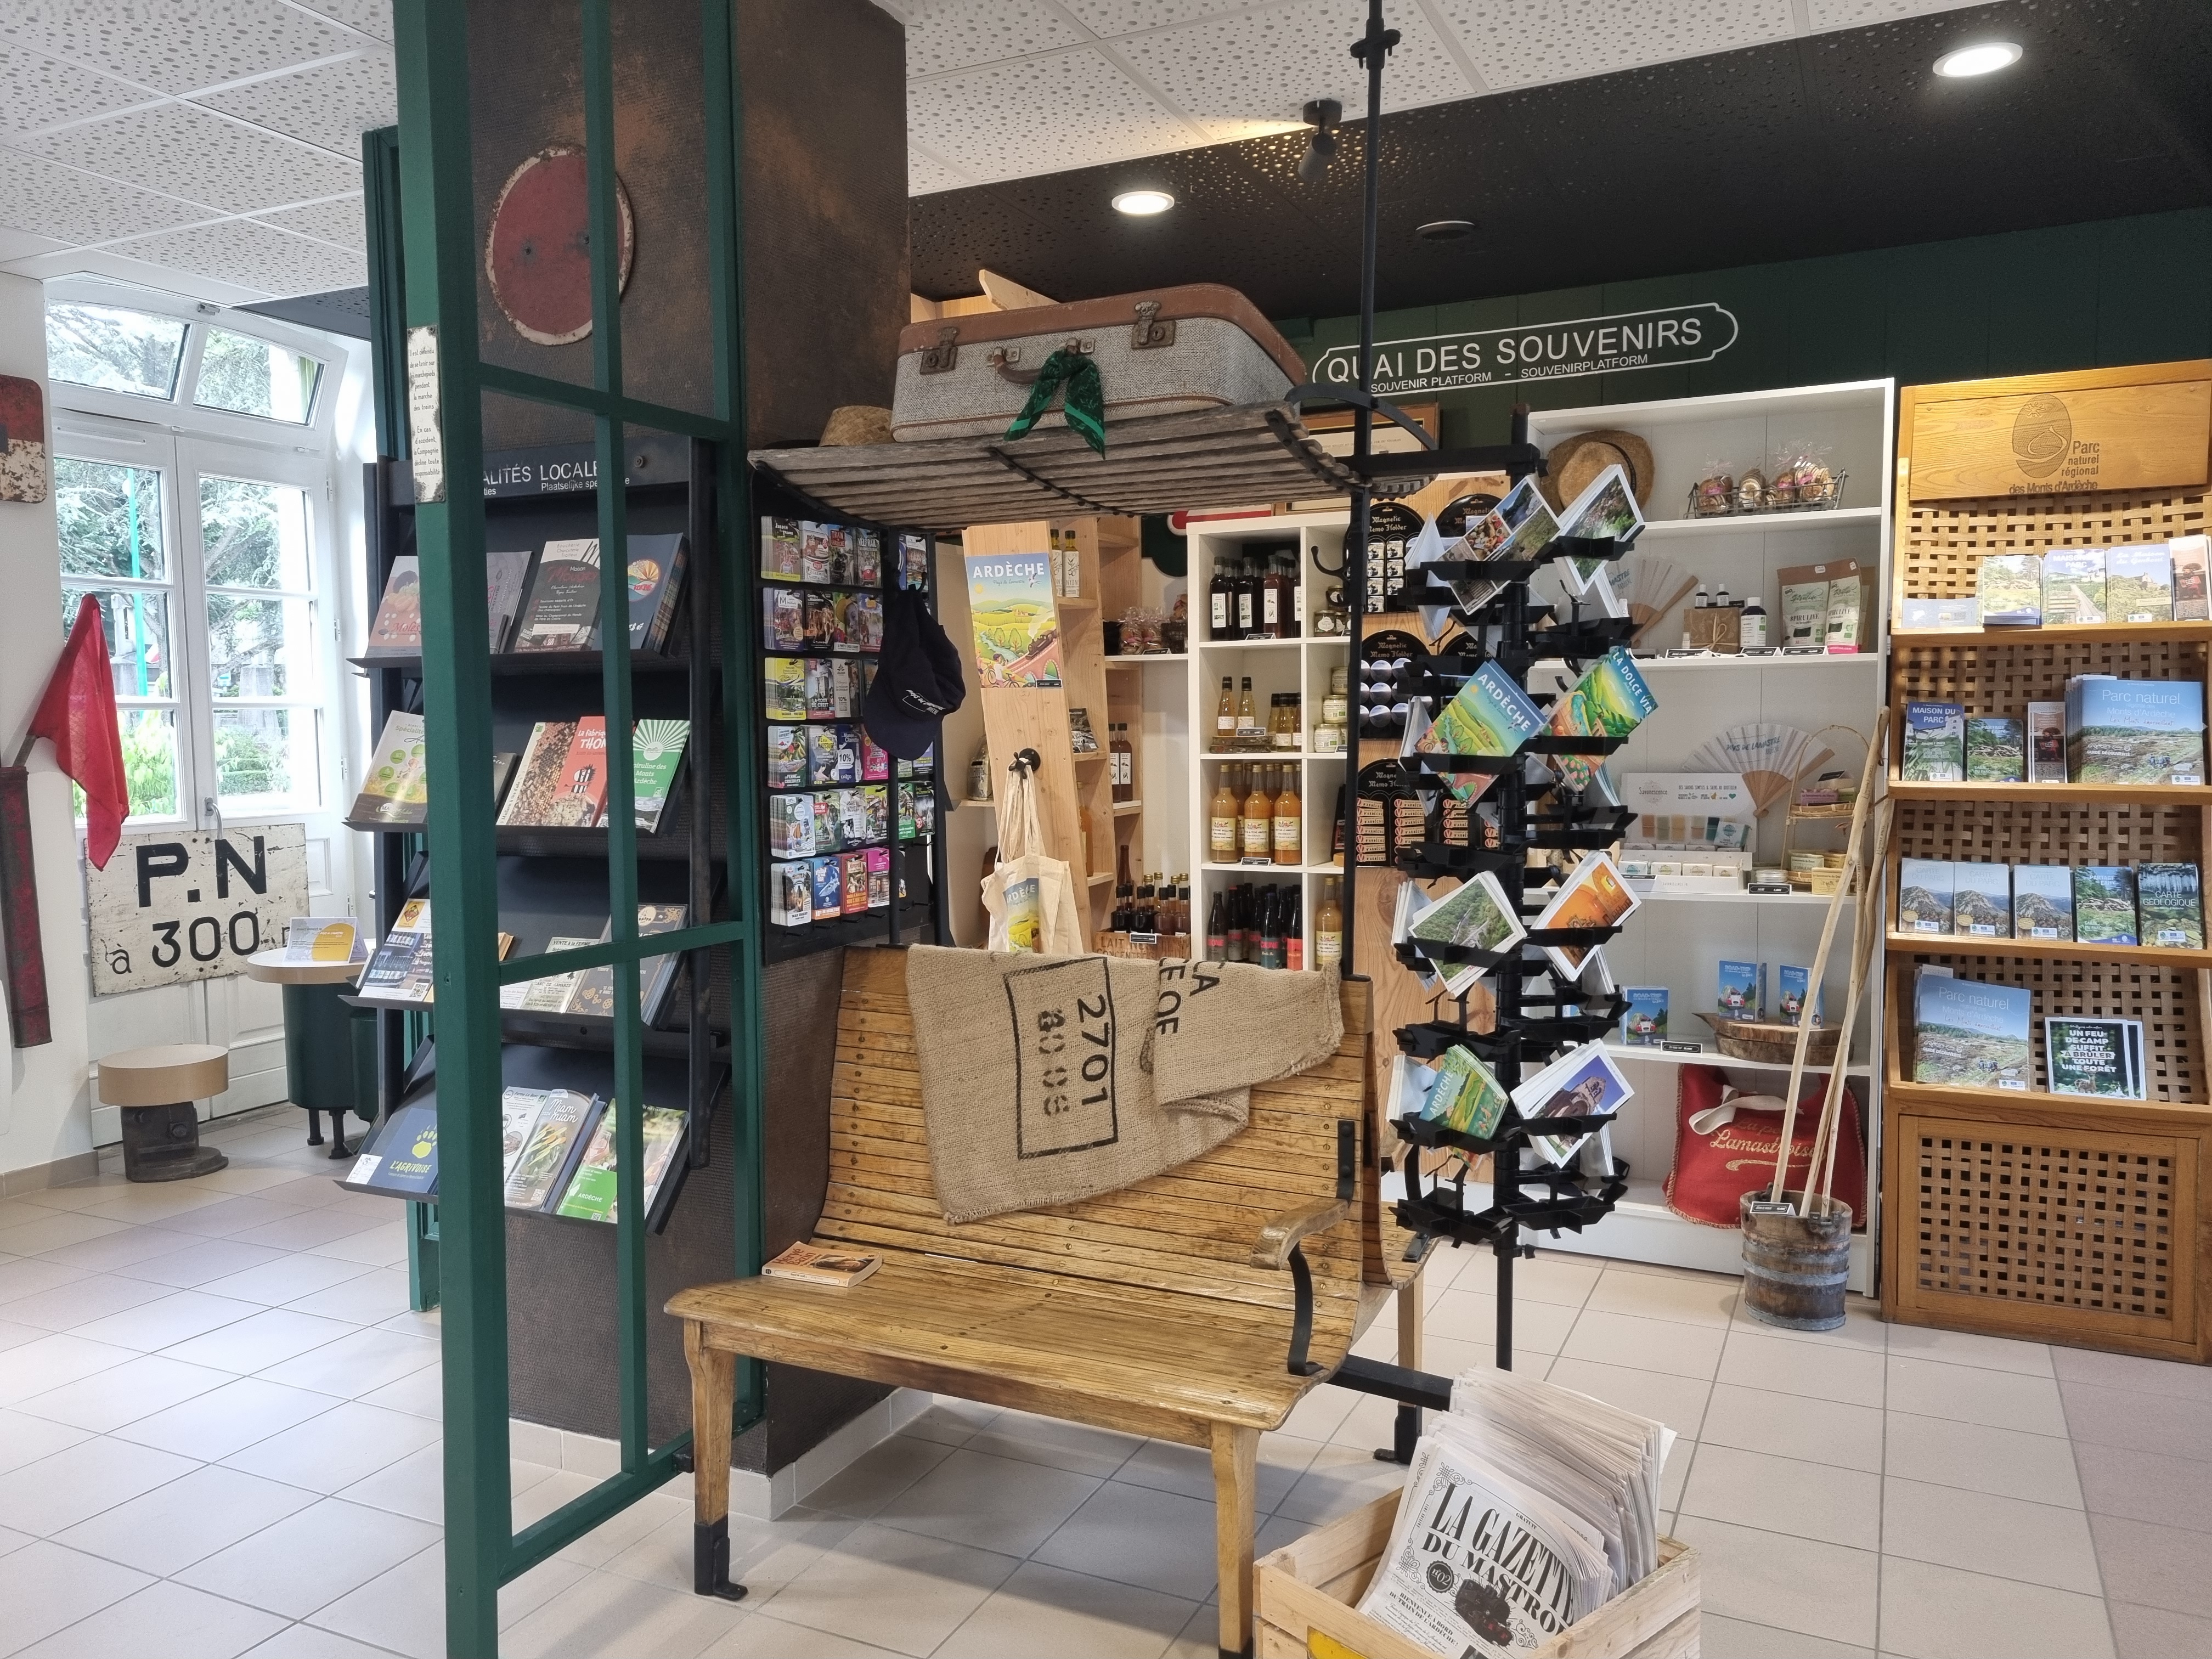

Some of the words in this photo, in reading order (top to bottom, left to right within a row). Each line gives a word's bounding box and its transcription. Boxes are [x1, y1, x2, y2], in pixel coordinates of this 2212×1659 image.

[1328, 352, 1402, 382] QUAI
[1417, 343, 1481, 374] DES
[1497, 318, 1701, 364] SOUVENIRS
[1371, 379, 1427, 393] SOUVENIR
[1431, 372, 1492, 386] PLATFORM
[1521, 354, 1647, 378] SOUVENIRPLATFORM
[2073, 441, 2100, 454] Parc
[2068, 454, 2100, 465] naturel
[540, 460, 597, 481] LOCALE
[2061, 465, 2098, 478] régional
[2009, 484, 2025, 494] des
[2027, 482, 2053, 493] Monts
[2055, 479, 2098, 492] d'Ardèche
[973, 561, 1045, 578] ARDÈCHE
[1790, 613, 1819, 621] SPIRULINE
[1612, 652, 1623, 665] LA
[1621, 665, 1643, 696] DOLCE
[1639, 695, 1652, 713] VIA
[1477, 674, 1531, 732] ARDÈCHE
[2102, 689, 2131, 702] Parc
[2136, 692, 2180, 704] naturel
[2107, 707, 2132, 715] Monts
[839, 754, 851, 762] 10%
[136, 835, 267, 908] P.N
[2142, 896, 2196, 906] GÉOLOGIQUE
[110, 944, 132, 975] à
[151, 910, 261, 968] 300
[1101, 936, 1125, 949] LAIT
[1938, 986, 1965, 1002] Parc
[1969, 995, 2009, 1010] naturel
[1077, 994, 1111, 1106] 2701
[1430, 1070, 1454, 1116] ARDÈCHE
[550, 1098, 577, 1113] Miam
[550, 1113, 579, 1124] miam
[389, 1160, 432, 1173] L'AGRIVOISE
[578, 1192, 603, 1203] ARDÈCHE
[773, 1248, 804, 1264] Hervé
[787, 1252, 816, 1266] Bazin
[1429, 1482, 1474, 1542] LA
[1516, 1511, 1537, 1530] GRATUIT
[1420, 1531, 1462, 1560] DU
[1389, 1591, 1398, 1599] DU
[1398, 1597, 1415, 1613] TRAIN
[1415, 1612, 1423, 1620] DE
[1400, 1592, 1433, 1620] BIENVENUE
[1436, 1618, 1453, 1636] BORD
